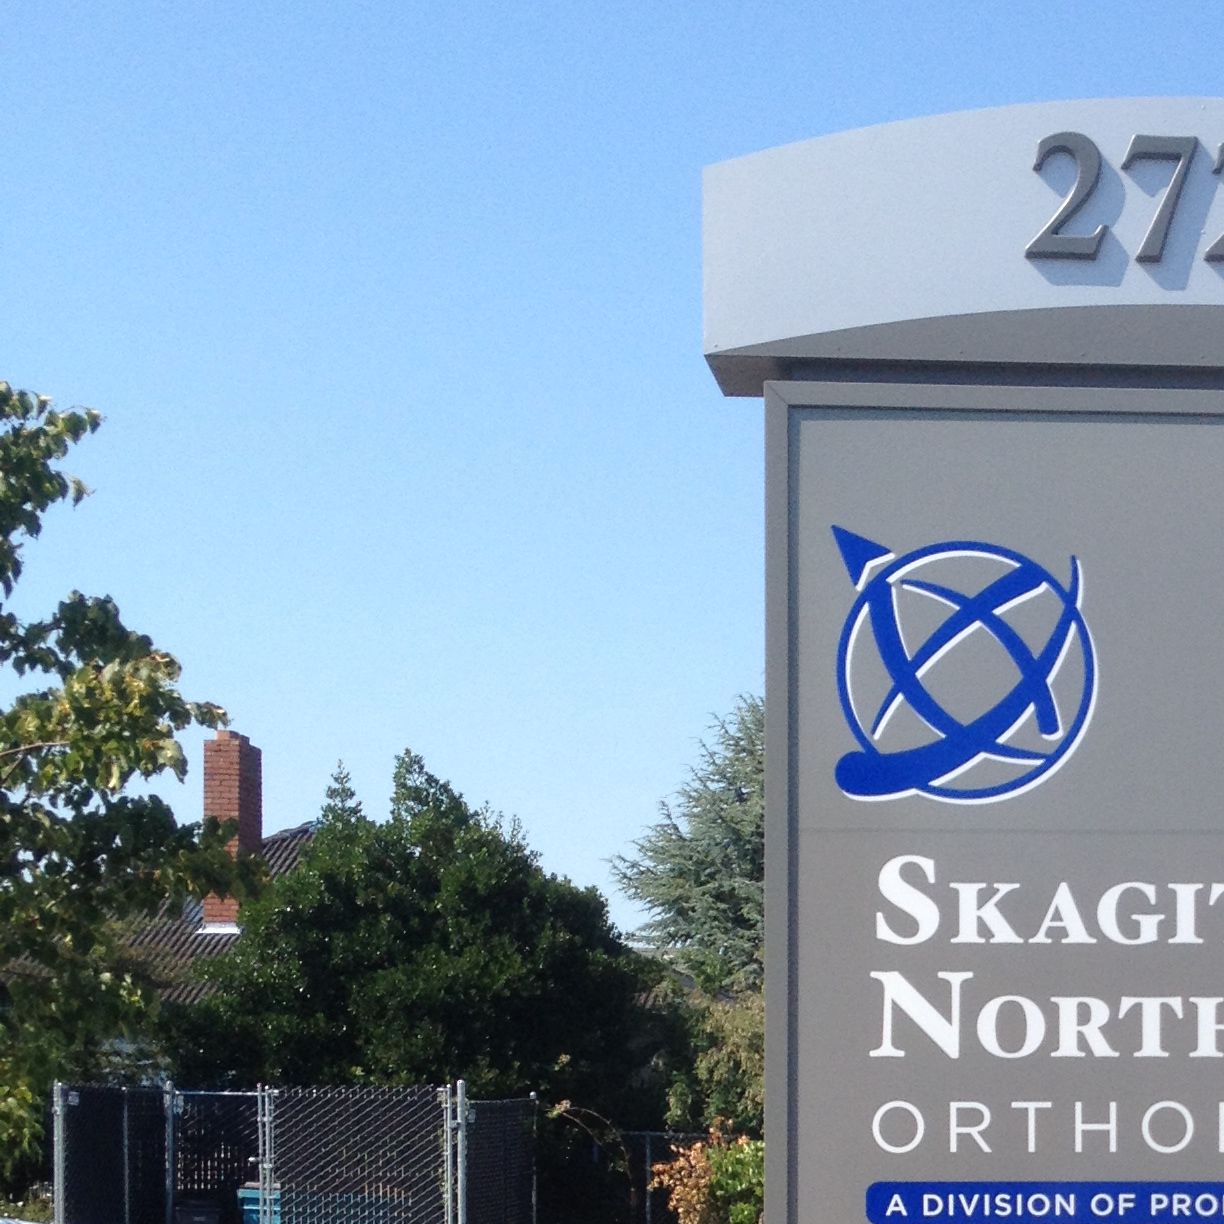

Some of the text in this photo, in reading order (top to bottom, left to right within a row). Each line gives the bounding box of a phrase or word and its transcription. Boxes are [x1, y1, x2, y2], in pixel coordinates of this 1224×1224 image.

[885, 1193, 907, 1217] A
[922, 1193, 1077, 1217] DIVISION
[1089, 1193, 1136, 1217] OF
